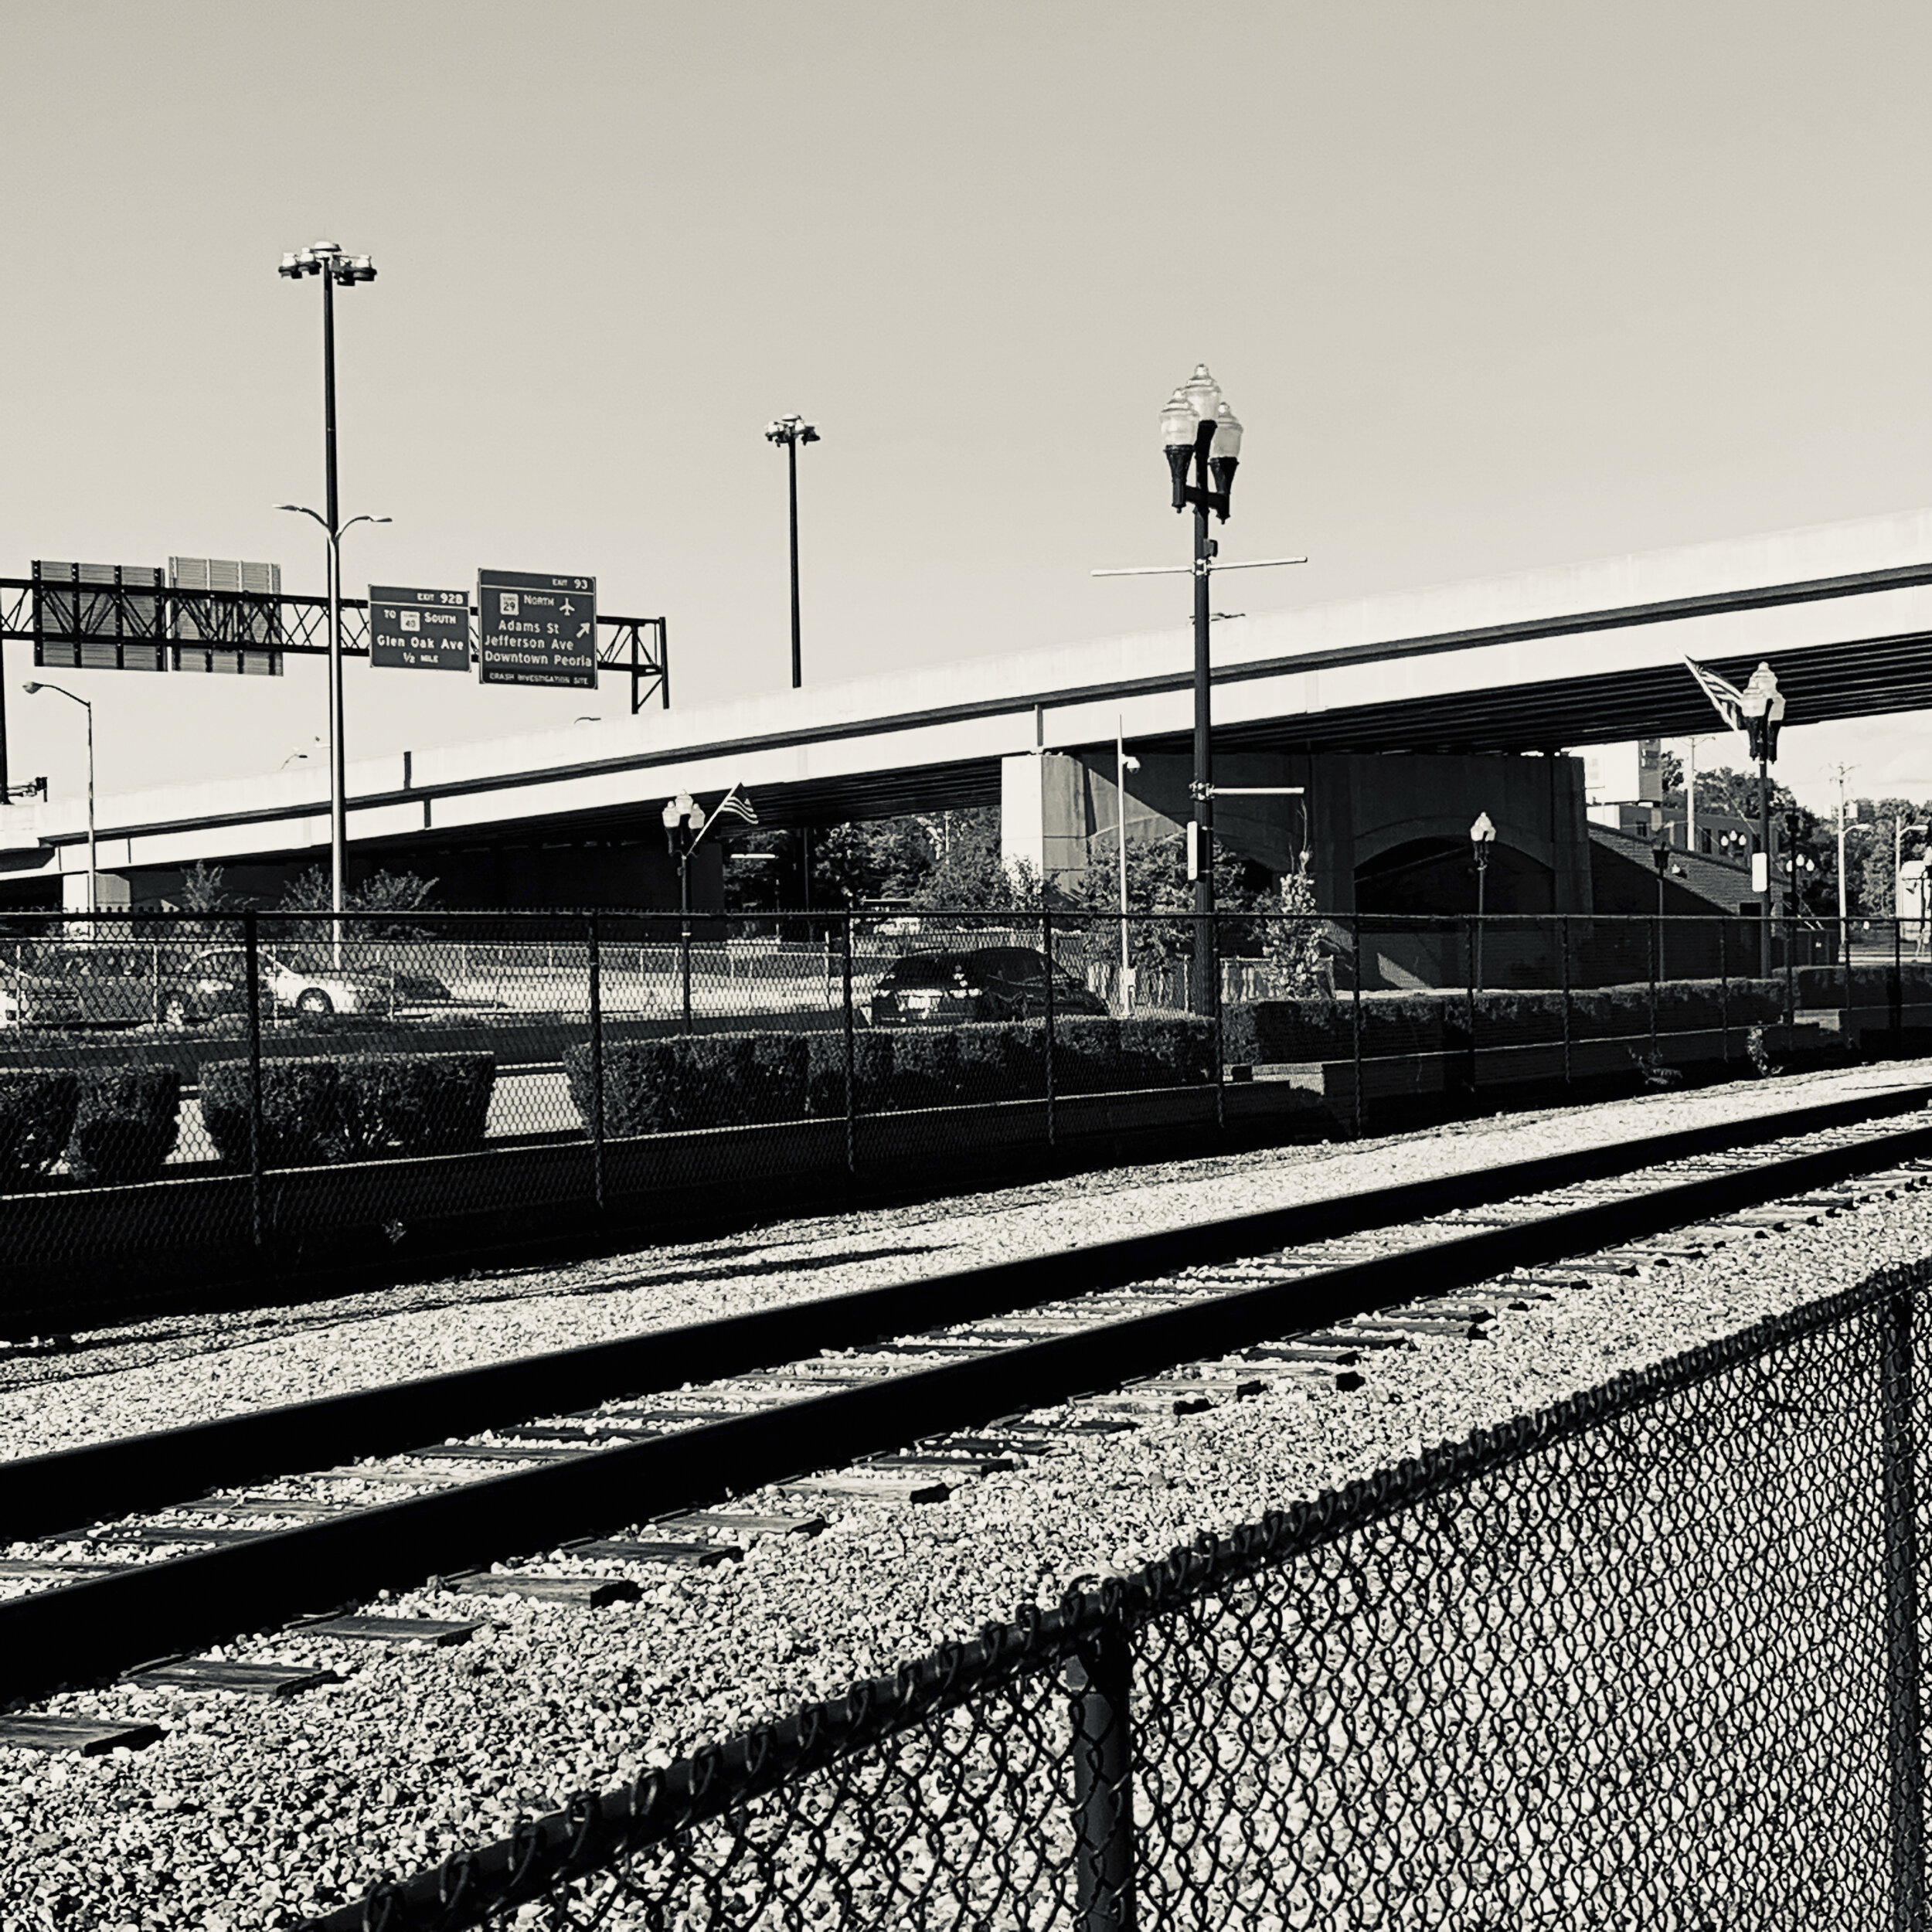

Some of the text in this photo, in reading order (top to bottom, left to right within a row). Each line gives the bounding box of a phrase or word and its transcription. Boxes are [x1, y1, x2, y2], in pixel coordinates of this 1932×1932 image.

[574, 579, 588, 590] 93
[440, 593, 464, 604] 92B
[523, 594, 555, 606] NORTH
[503, 601, 515, 611] 29
[383, 609, 396, 619] TO
[423, 611, 457, 624] SOUTH
[498, 620, 560, 634] Adams St
[376, 634, 464, 650] Glen Oak Ave
[485, 634, 574, 651] Jefferson Ave
[485, 650, 593, 667] Downtown Peoria
